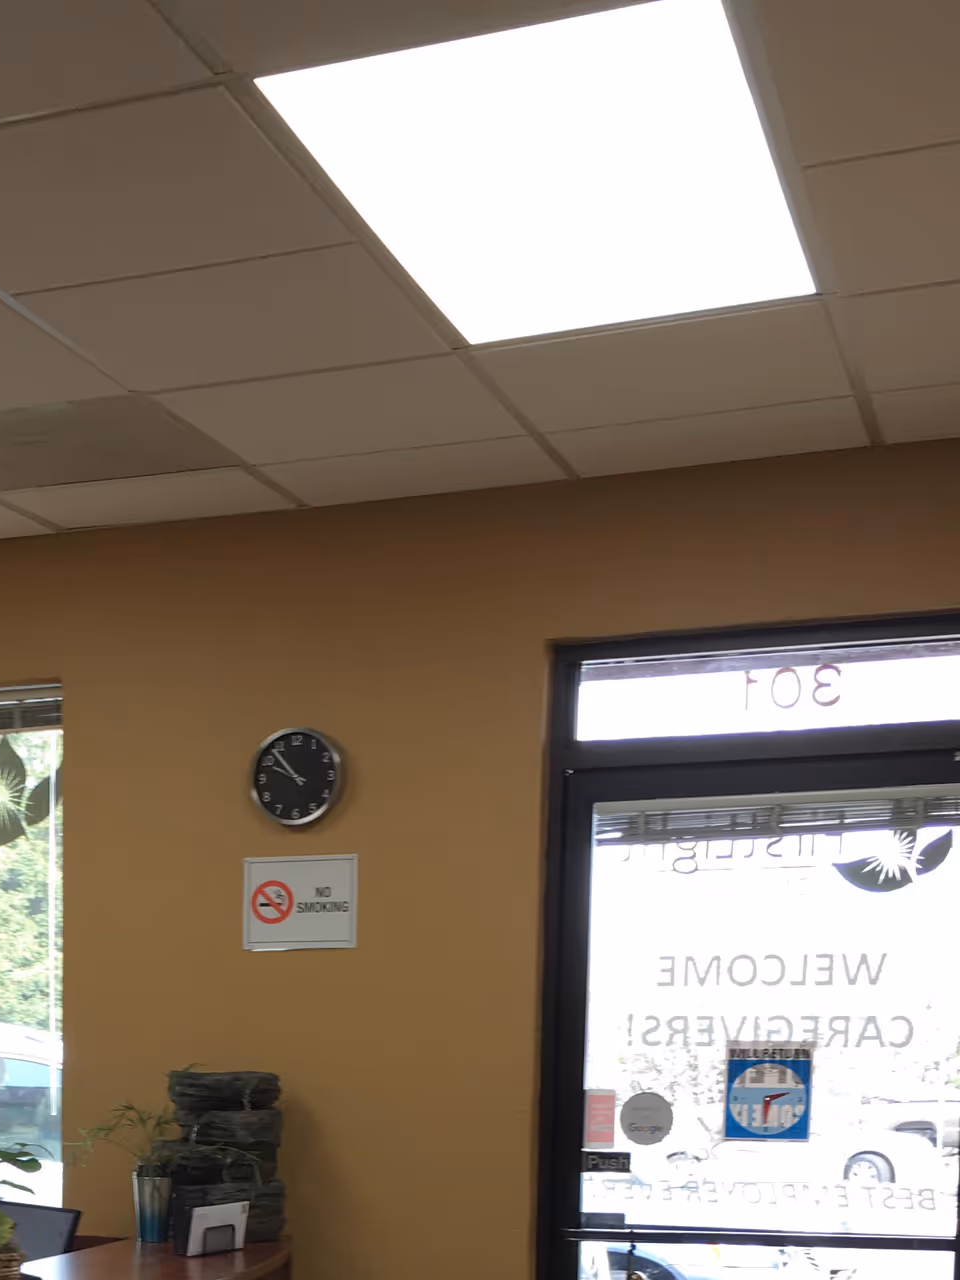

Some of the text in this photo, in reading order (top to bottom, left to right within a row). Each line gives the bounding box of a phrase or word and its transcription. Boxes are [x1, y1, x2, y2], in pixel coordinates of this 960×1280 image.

[291, 735, 303, 746] 12
[321, 752, 331, 763] 2
[257, 774, 267, 784] 9
[326, 770, 336, 781] 3
[262, 792, 271, 802] 8
[274, 804, 283, 815] 7
[291, 808, 301, 819] 6
[308, 803, 318, 814] 5
[314, 886, 331, 899] NO
[296, 901, 349, 914] SMOKING
[588, 1154, 629, 1169] Push
